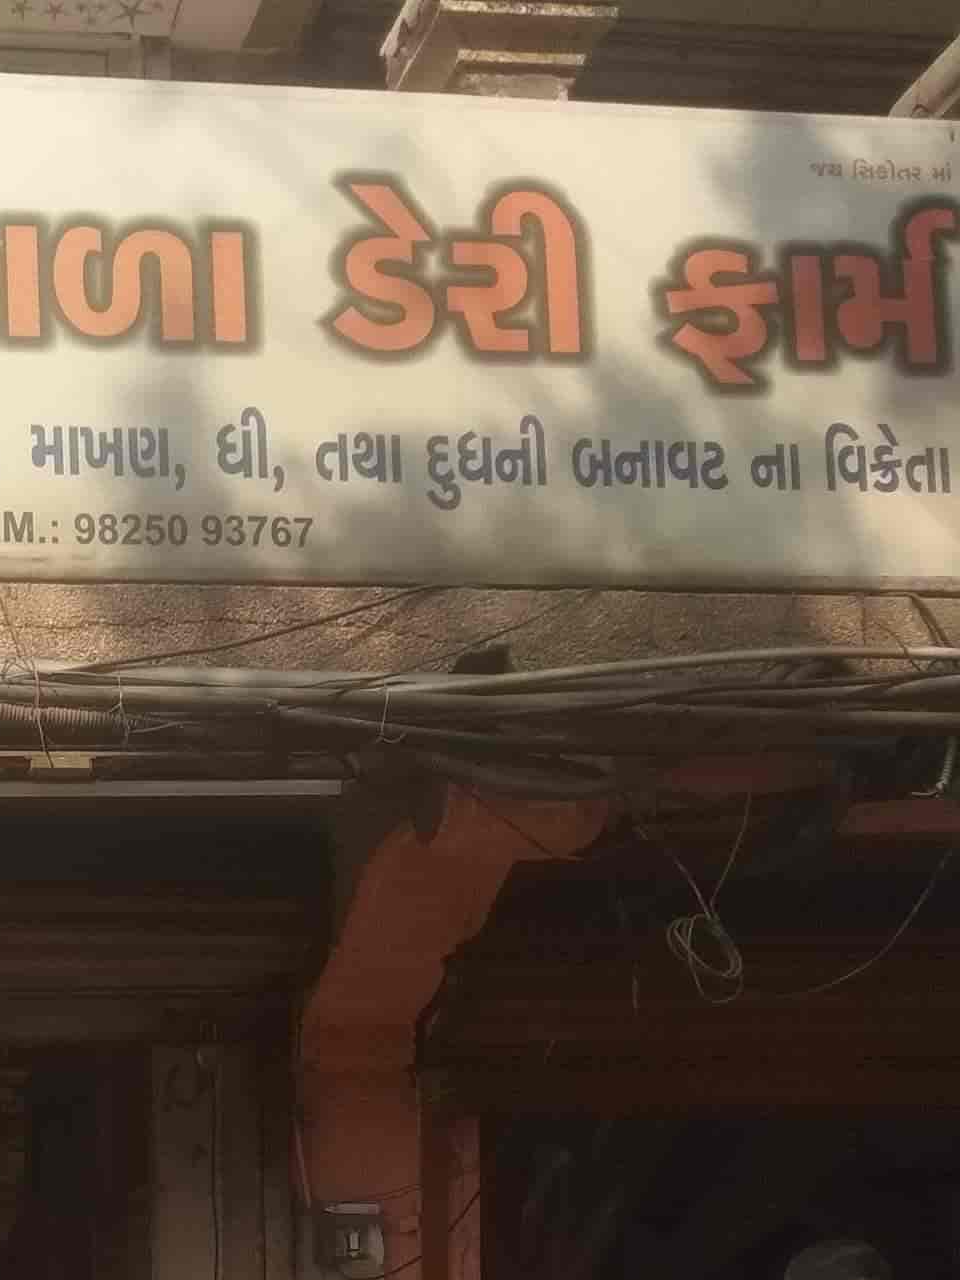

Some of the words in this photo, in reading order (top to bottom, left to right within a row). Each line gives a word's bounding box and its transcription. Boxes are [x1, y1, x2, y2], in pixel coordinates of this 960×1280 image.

[326, 178, 586, 357] ડેરી
[659, 202, 958, 388] ફાર્મ
[30, 423, 187, 491] માખણ,
[215, 405, 285, 493] ઘી,
[315, 431, 402, 483] તથા
[425, 413, 548, 511] દુધની
[571, 437, 729, 490] બનાવટ
[750, 443, 802, 491] ના
[824, 422, 953, 494] વિક્રેતા
[2, 510, 60, 545] M.:
[73, 512, 189, 546] 98250
[200, 516, 314, 548] 93767
